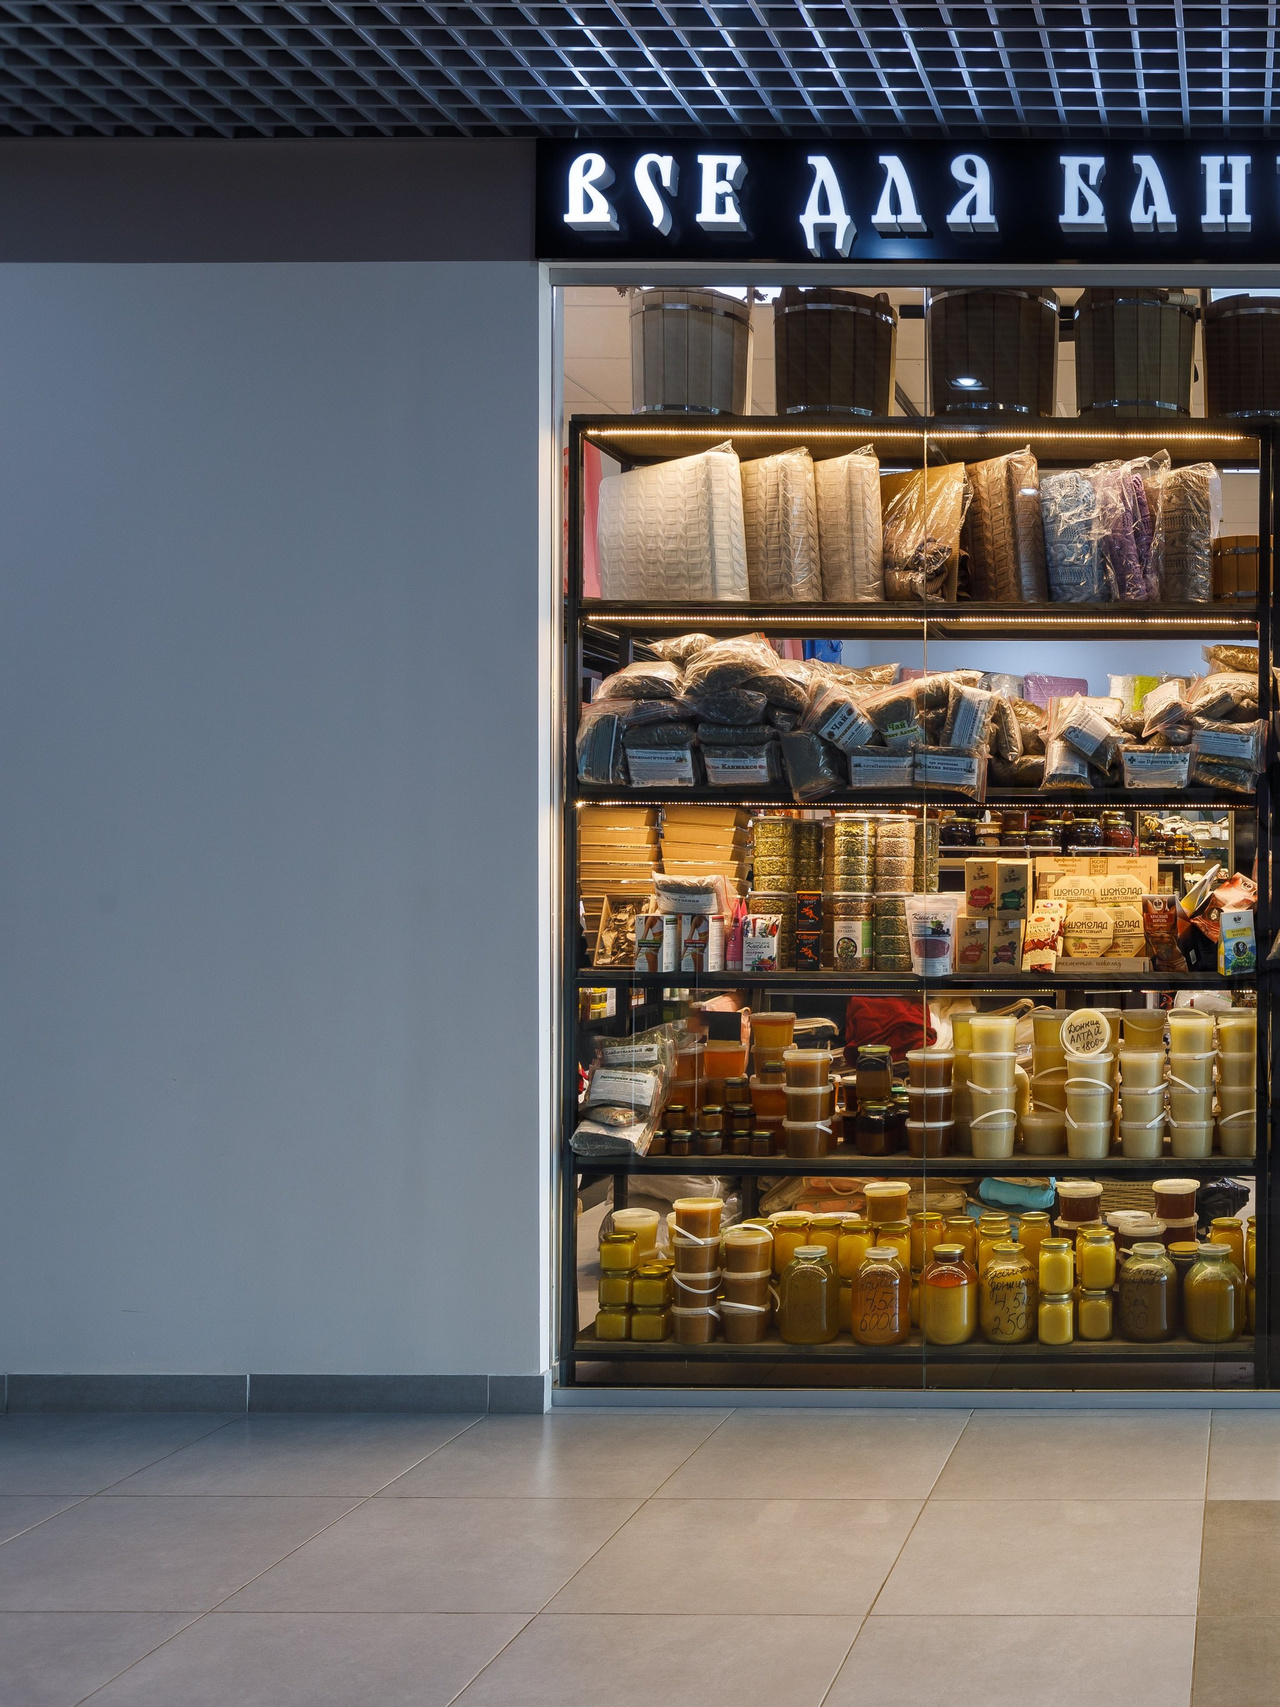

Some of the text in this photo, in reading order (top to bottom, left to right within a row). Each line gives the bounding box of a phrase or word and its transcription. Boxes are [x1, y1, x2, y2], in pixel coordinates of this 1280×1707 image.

[563, 153, 750, 236] ВСЕ
[800, 154, 1000, 257] ДЛЯ
[832, 714, 849, 732] Чай
[889, 721, 906, 731] Чай
[1100, 887, 1143, 897] ШОКОЛАД
[1067, 921, 1107, 930] ШОКОЛАД
[1114, 920, 1140, 929] КОЛАД
[1068, 1020, 1102, 1034] Донник
[1070, 1027, 1102, 1045] АЛТАЙ
[991, 1312, 1035, 1336] 2500
